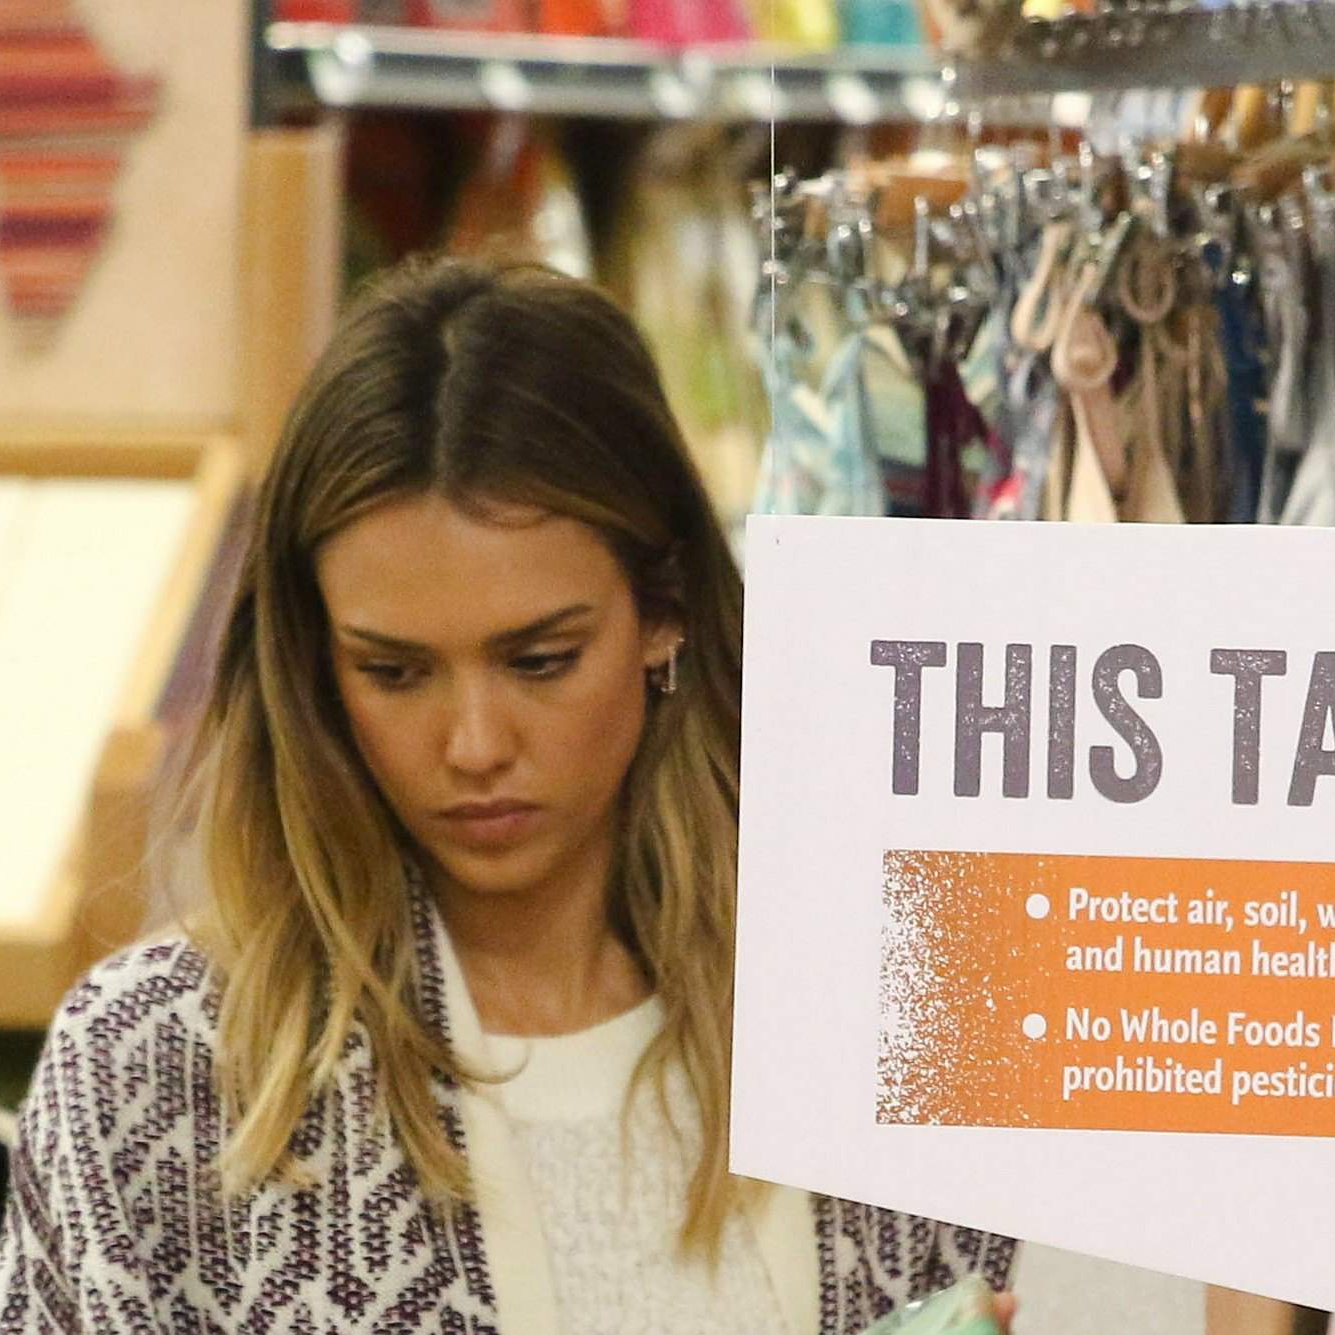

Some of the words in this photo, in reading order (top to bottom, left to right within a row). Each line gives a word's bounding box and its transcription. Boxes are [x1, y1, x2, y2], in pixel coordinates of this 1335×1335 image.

[870, 640, 1163, 804] THIS
[1068, 887, 1178, 925] Protect
[1188, 888, 1234, 932] air,
[1243, 890, 1308, 934] soil,
[1065, 936, 1124, 972] and
[1133, 936, 1242, 975] human
[1065, 1007, 1112, 1042] No
[1120, 1009, 1218, 1045] Whole
[1227, 1010, 1321, 1048] Foods
[1064, 1056, 1224, 1101] prohibited
